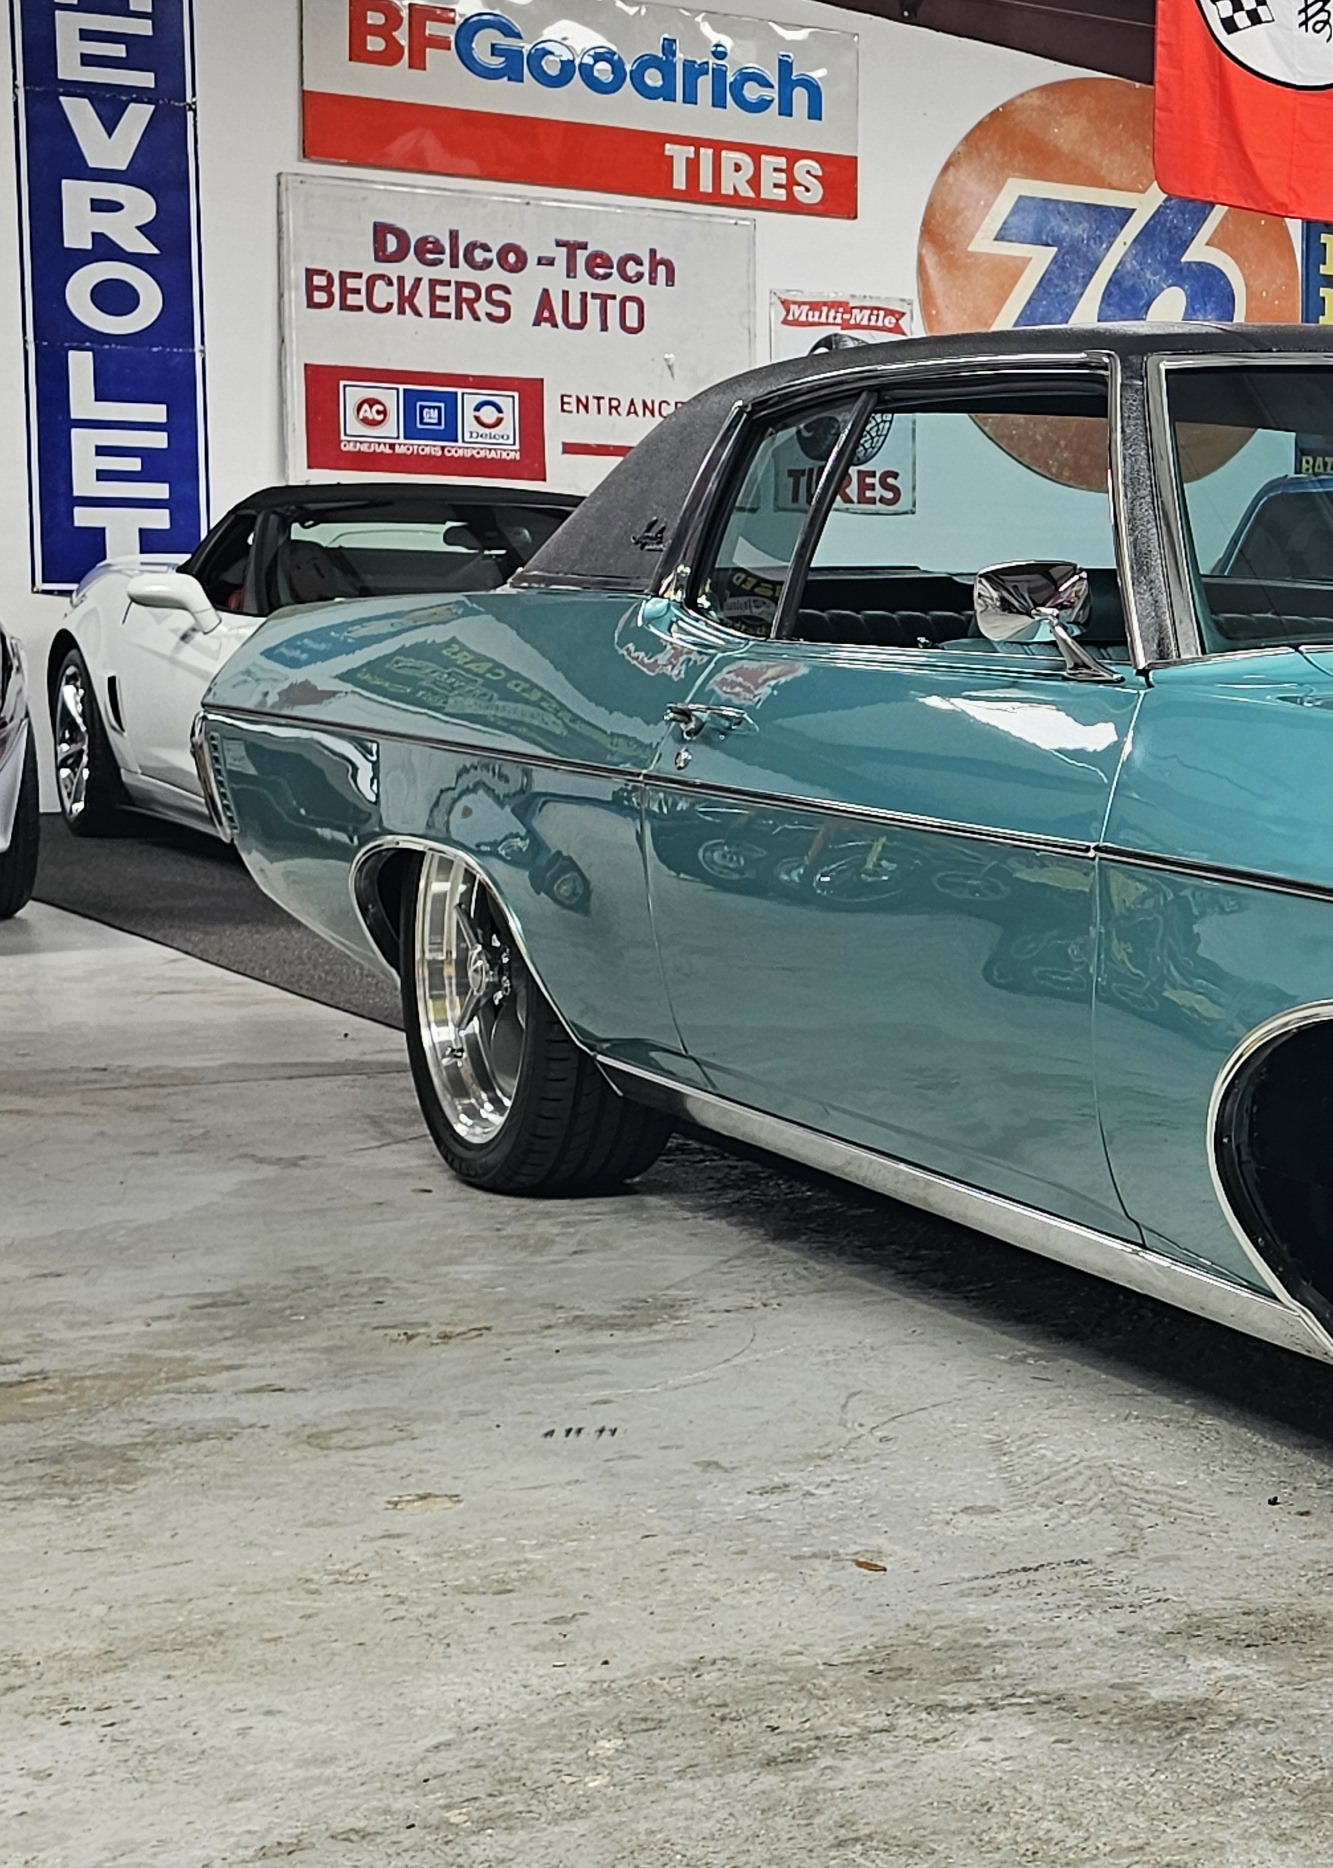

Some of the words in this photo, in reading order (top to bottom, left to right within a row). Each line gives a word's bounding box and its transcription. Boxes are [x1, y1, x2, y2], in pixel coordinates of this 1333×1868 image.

[348, 0, 823, 121] BFGoodrich
[664, 143, 825, 204] TIRES
[970, 178, 1246, 326] 76
[55, 0, 170, 572] EVROLET
[304, 267, 512, 324] BECKERS
[532, 288, 646, 335] AUTO
[785, 303, 899, 330] Multi-Mile
[358, 403, 385, 421] AC
[423, 408, 438, 423] GM
[340, 441, 392, 454] GENERAL
[395, 443, 441, 456] MOTORS
[444, 446, 520, 460] CORPORATION
[468, 430, 510, 441] Delco
